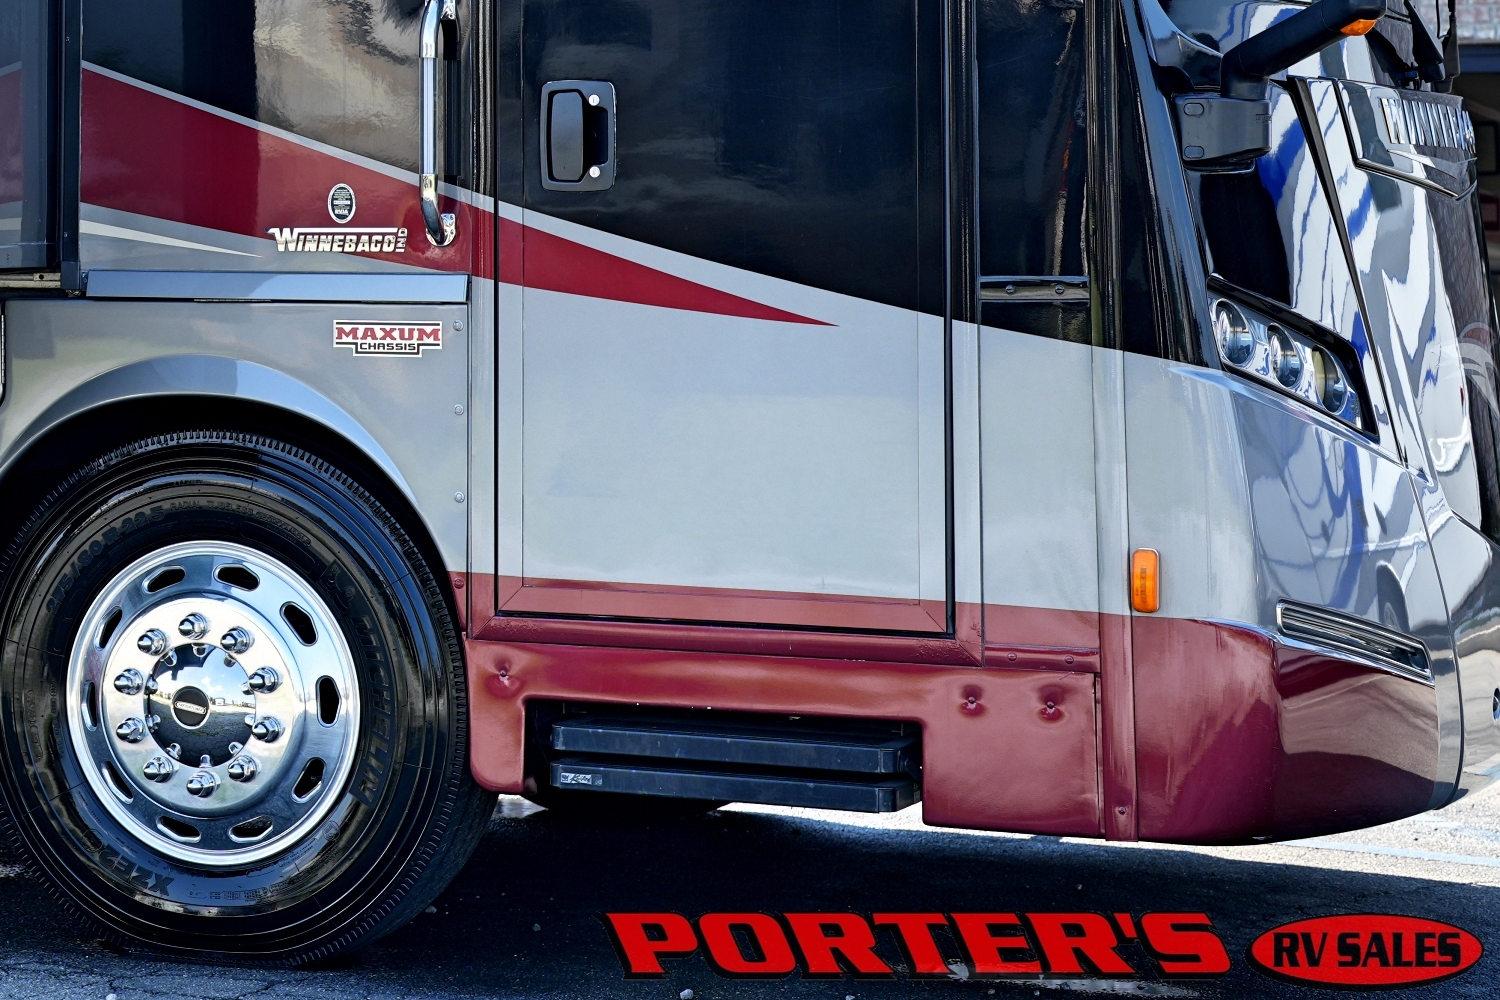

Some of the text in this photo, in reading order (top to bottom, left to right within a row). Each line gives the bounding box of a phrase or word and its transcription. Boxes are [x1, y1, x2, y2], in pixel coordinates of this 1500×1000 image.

[264, 227, 398, 252] WINNEBAGO
[335, 326, 441, 342] MAXUM
[359, 342, 417, 351] CHASSIS
[351, 614, 392, 803] MICHELIN
